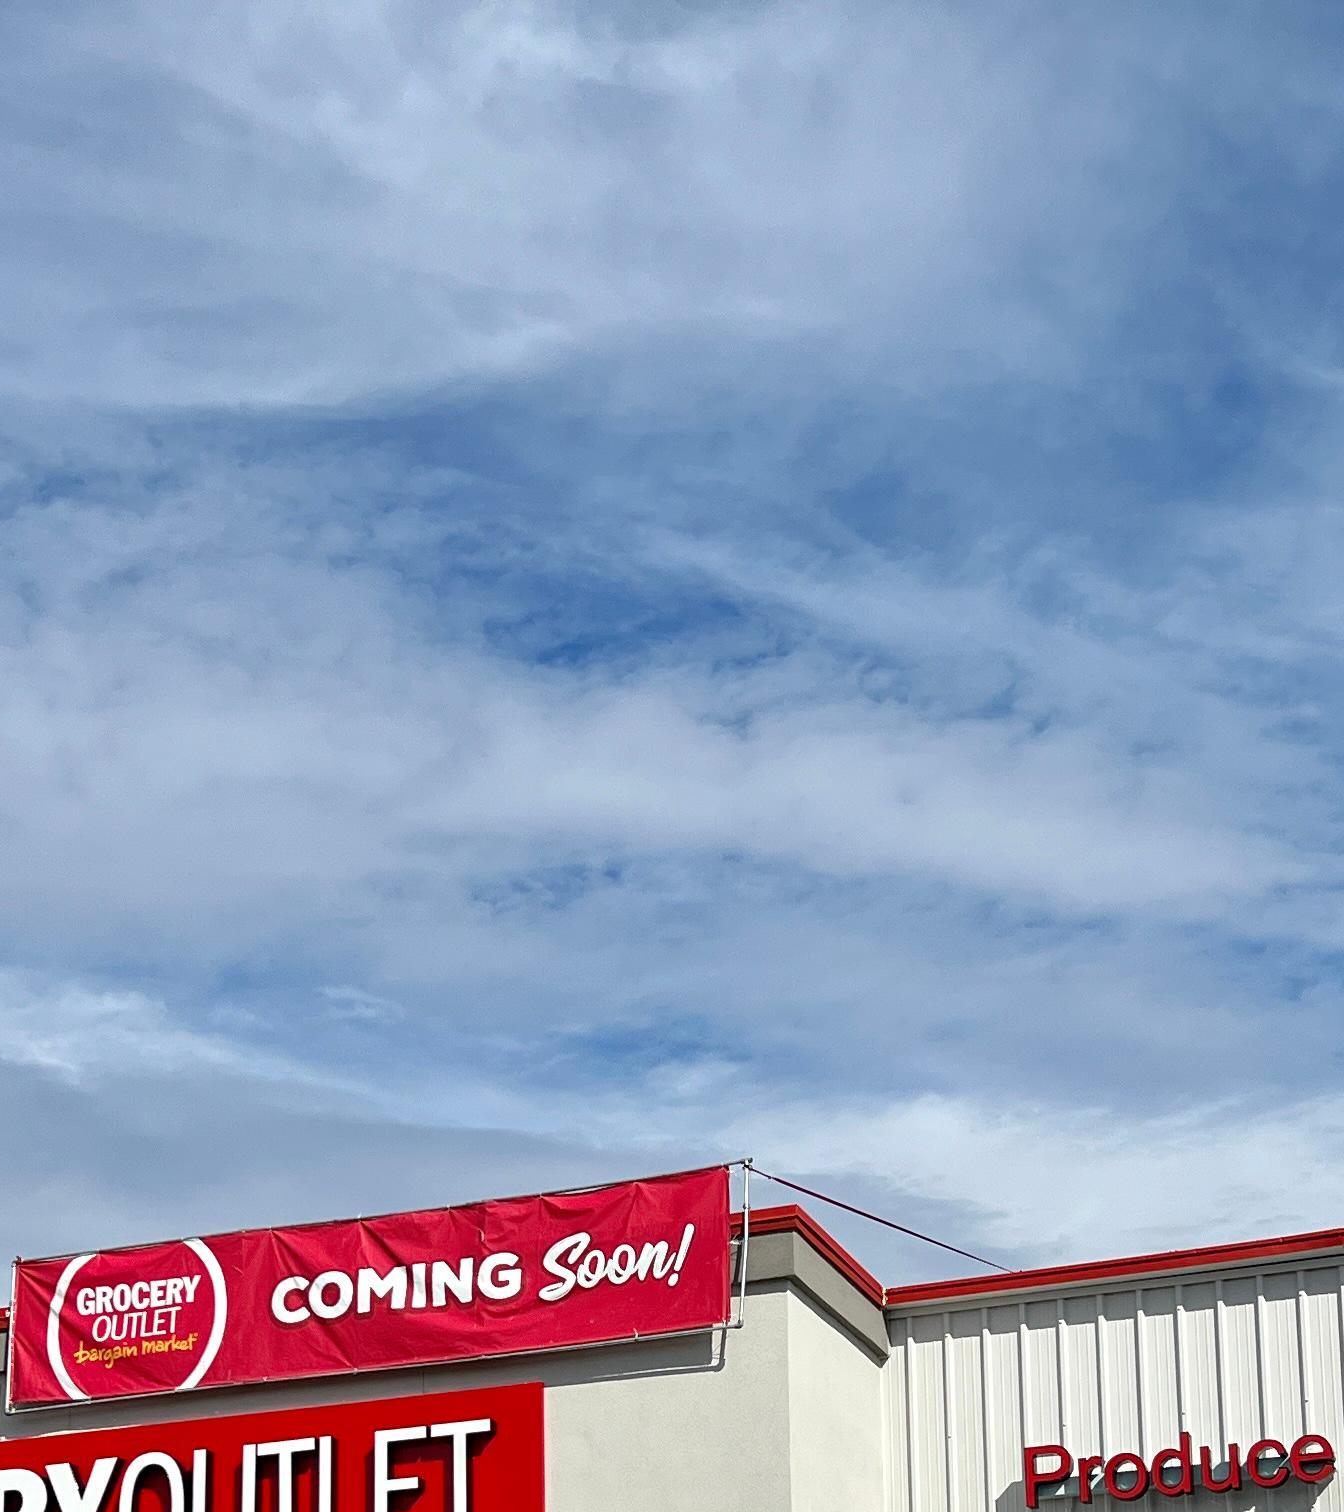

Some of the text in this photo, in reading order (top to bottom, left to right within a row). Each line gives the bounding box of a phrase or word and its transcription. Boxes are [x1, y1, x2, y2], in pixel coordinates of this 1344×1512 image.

[270, 1222, 696, 1325] COMING Soon!
[75, 1274, 202, 1317] GROCERY
[91, 1306, 183, 1343] OUTLET
[73, 1332, 198, 1370] bargain market
[1021, 1427, 1337, 1510] Produce
